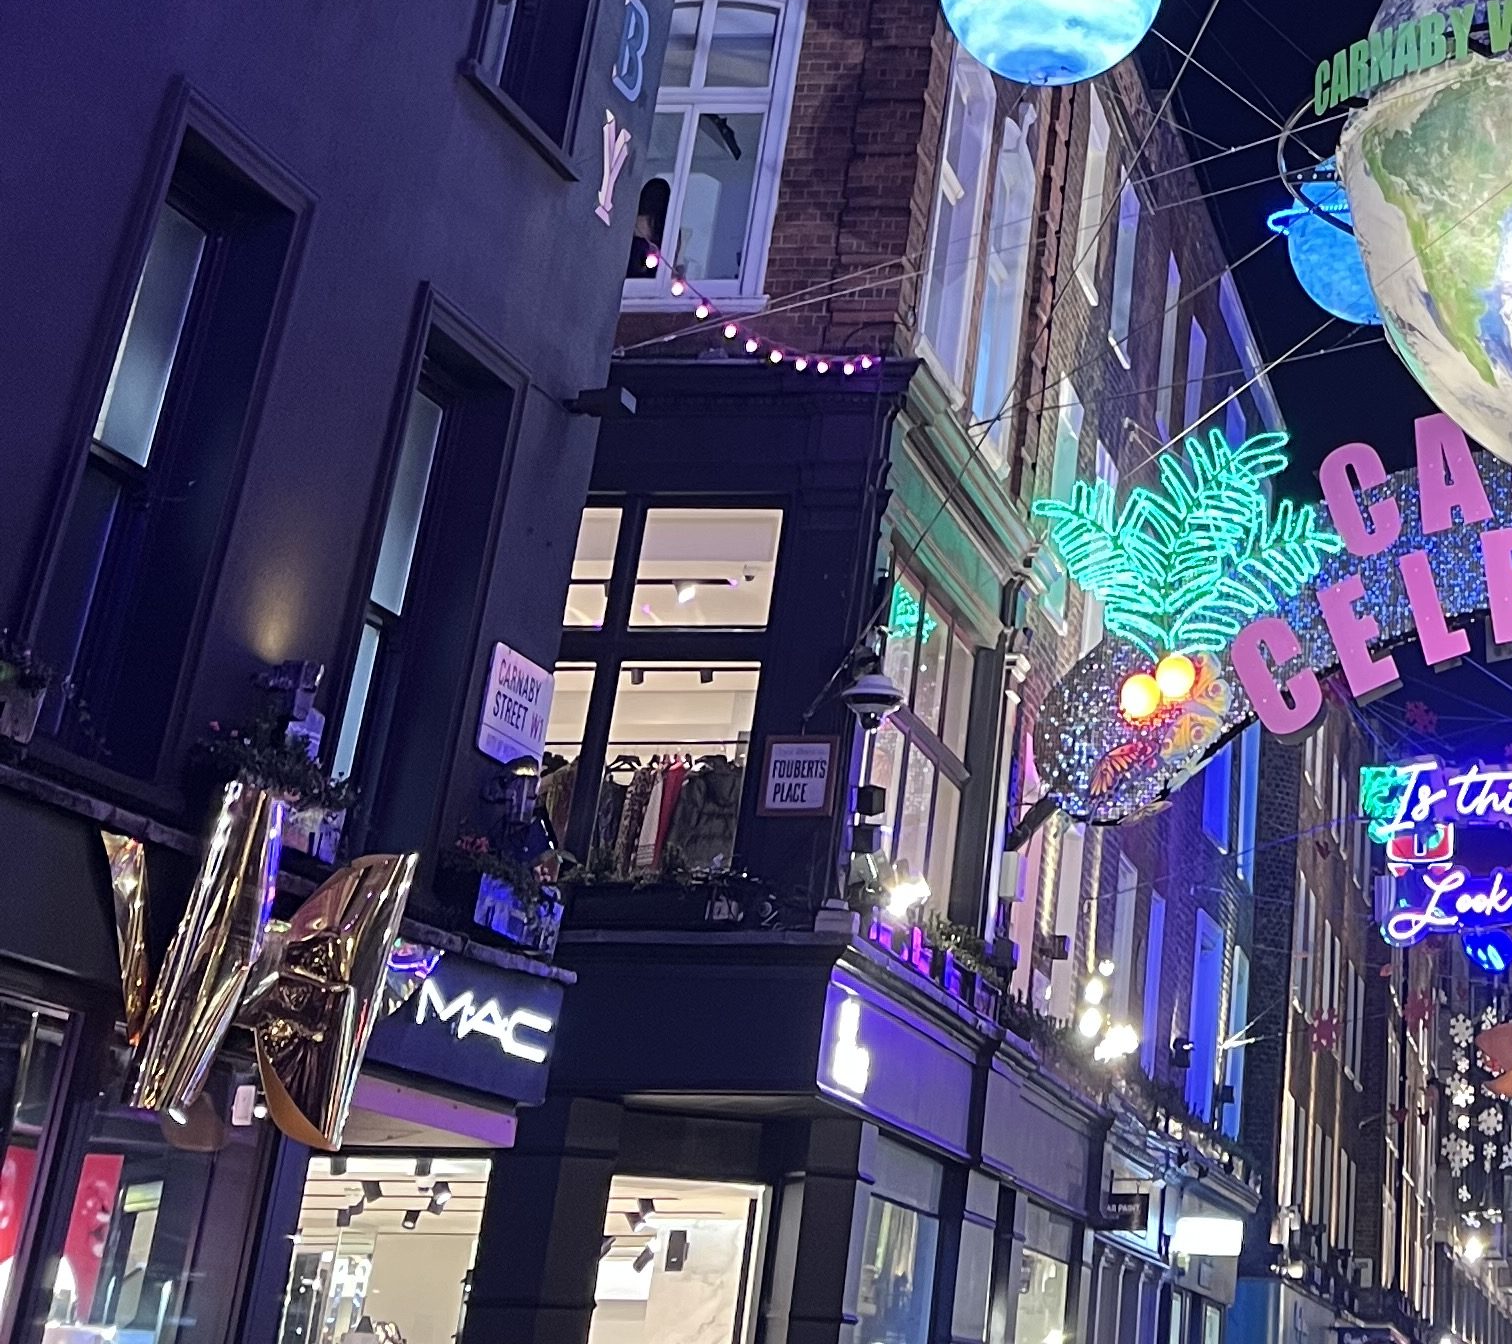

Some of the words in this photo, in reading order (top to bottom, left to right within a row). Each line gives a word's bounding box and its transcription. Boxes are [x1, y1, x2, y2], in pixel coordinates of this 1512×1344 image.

[1314, 2, 1476, 116] CARNABY
[499, 658, 541, 705] CARNABY
[493, 690, 529, 732] STREET
[529, 713, 544, 742] W1
[772, 783, 808, 802] PLACE
[1375, 761, 1448, 834] Is
